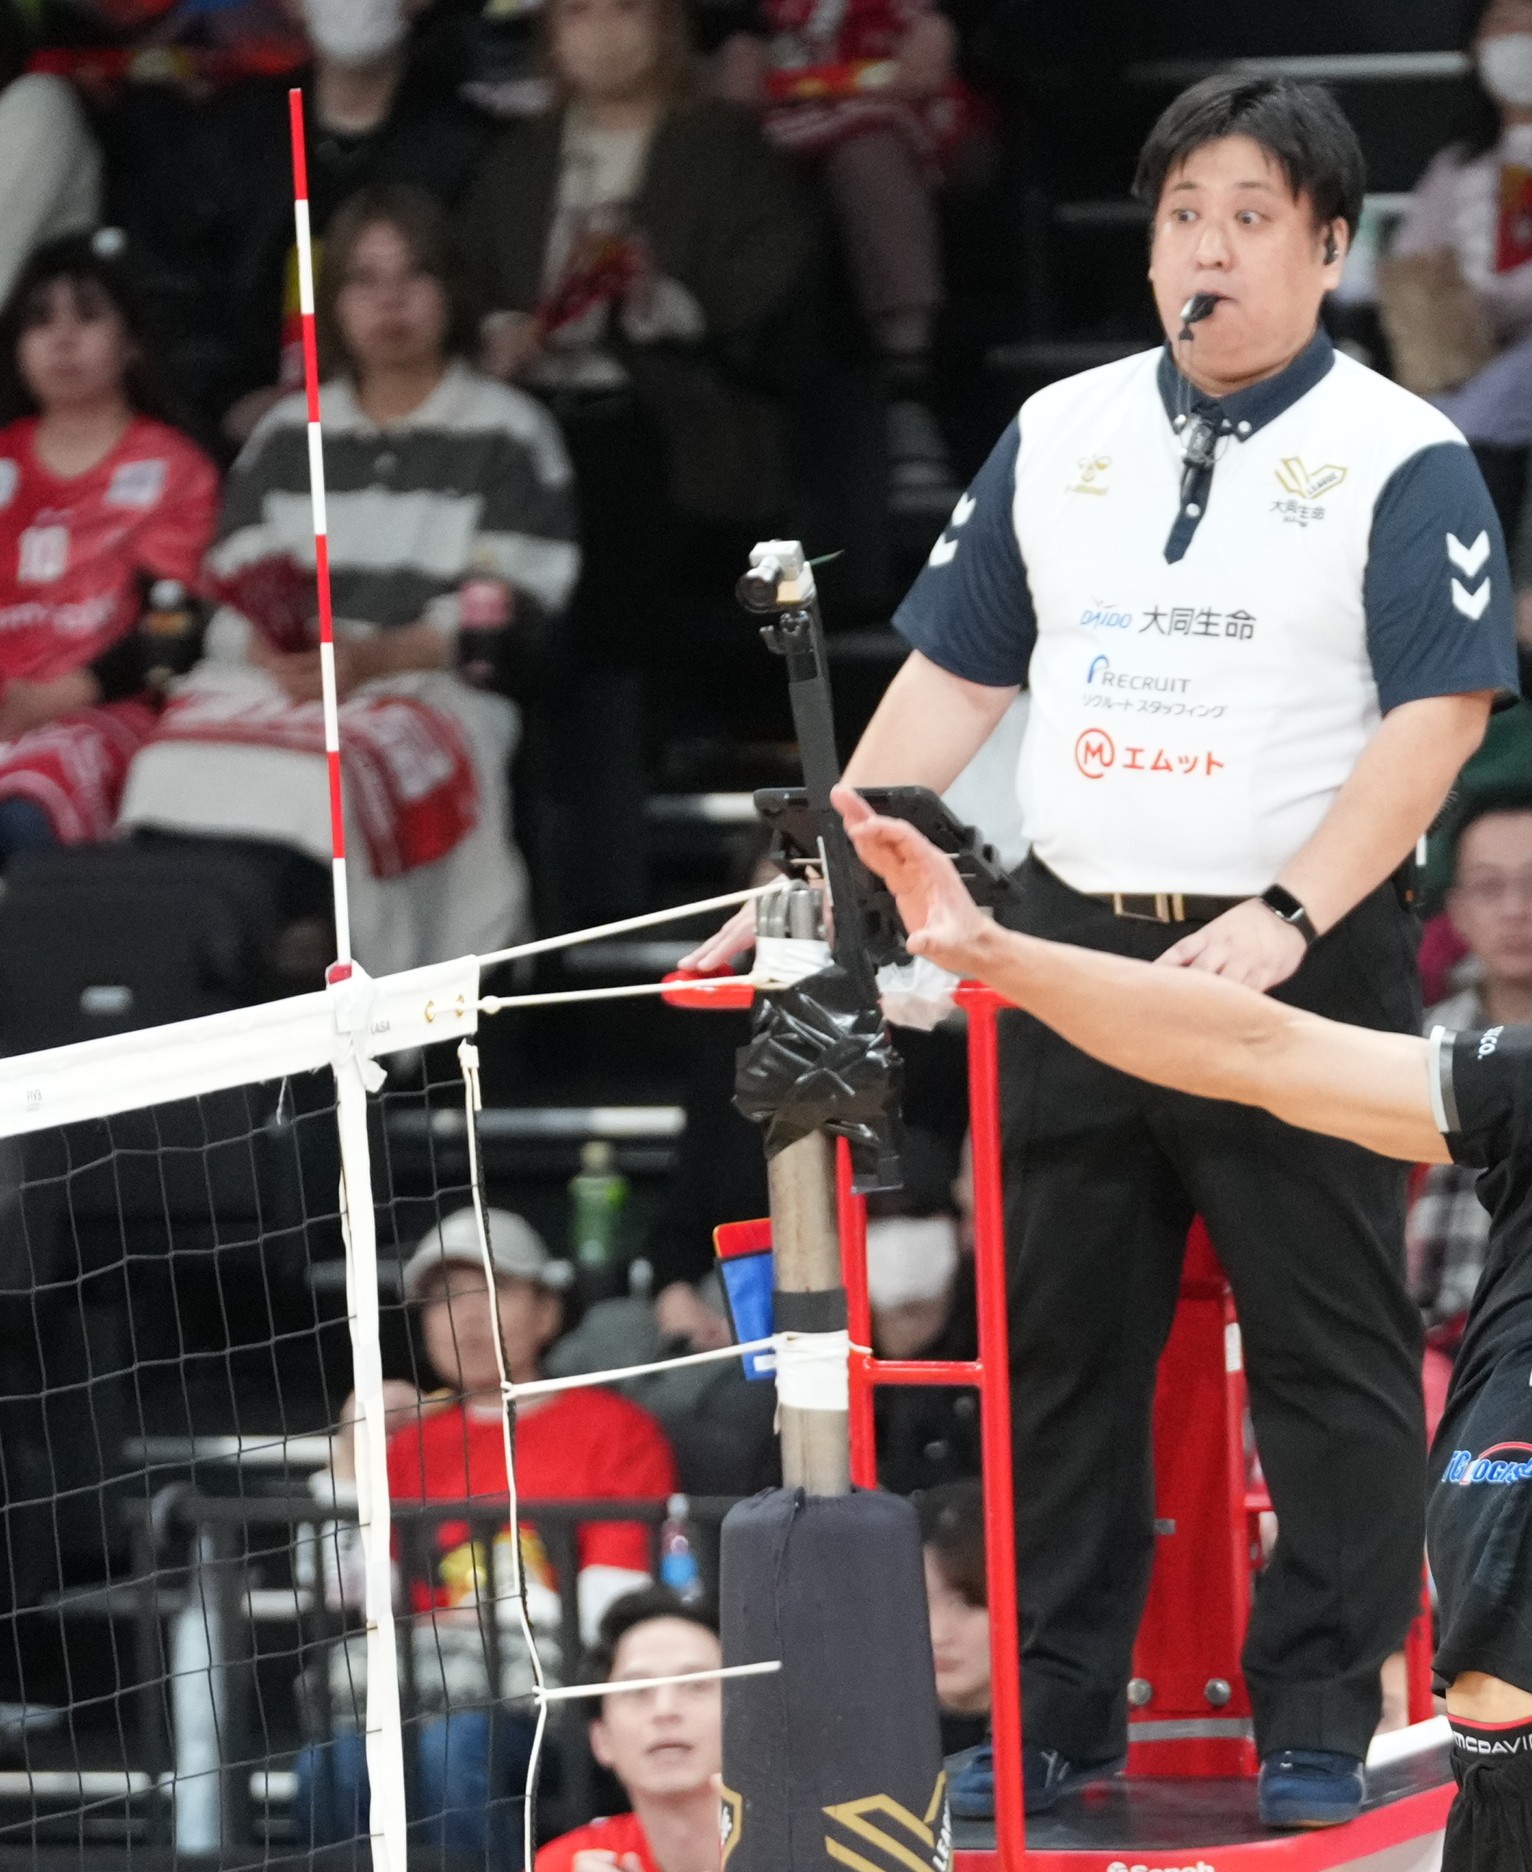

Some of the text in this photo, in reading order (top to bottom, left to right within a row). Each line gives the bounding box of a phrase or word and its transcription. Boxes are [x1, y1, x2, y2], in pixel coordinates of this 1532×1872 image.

[1138, 605, 1257, 640] 大同生命
[1101, 671, 1192, 693] RECRUIT
[1122, 747, 1225, 776] エムット
